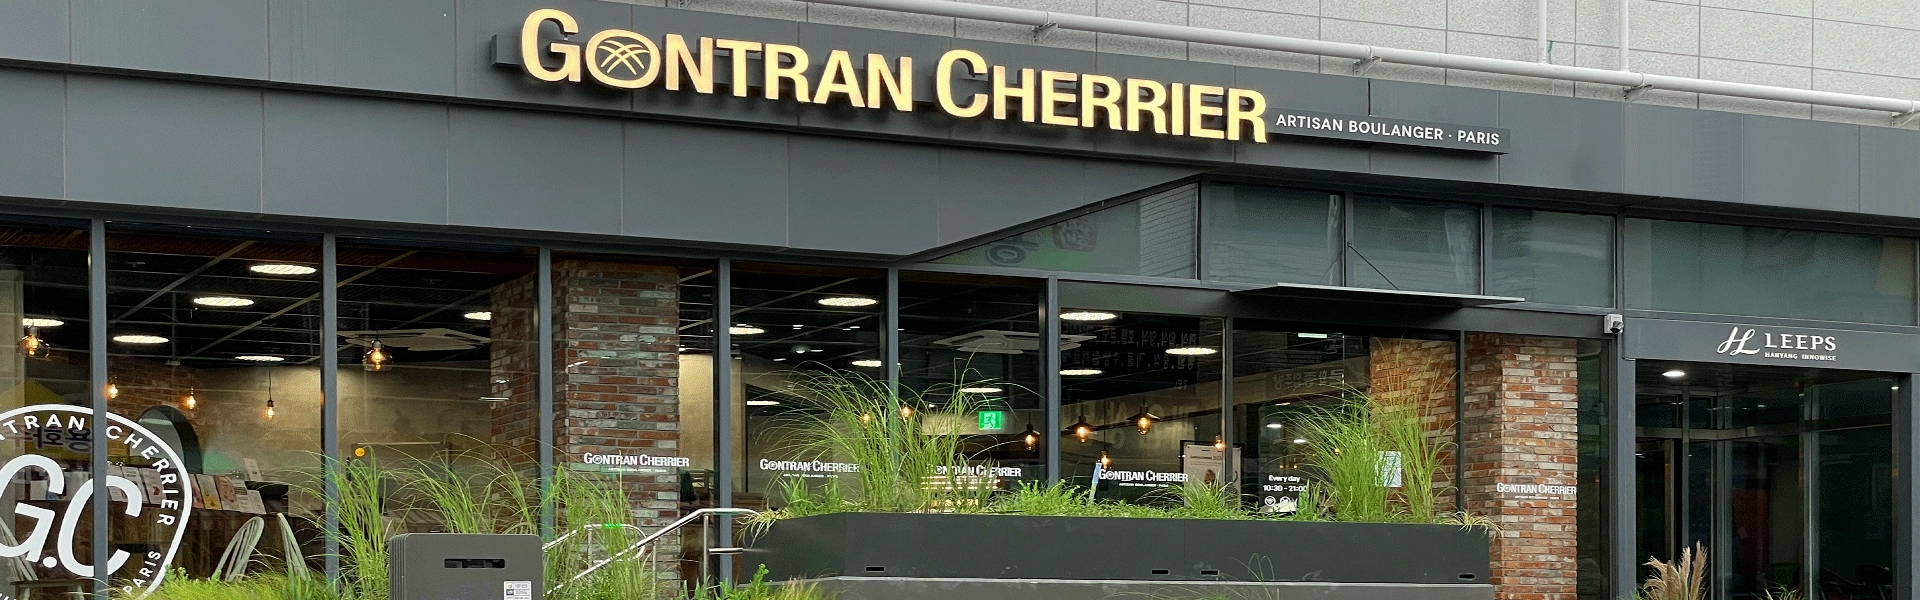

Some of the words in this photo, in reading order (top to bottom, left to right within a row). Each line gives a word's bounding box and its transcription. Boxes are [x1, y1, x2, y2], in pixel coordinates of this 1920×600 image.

[521, 8, 912, 111] GONTRAN
[936, 49, 1268, 144] CHERRIER
[1276, 114, 1343, 132] ARTISAN
[1349, 120, 1443, 141] BOULANGER
[1457, 129, 1500, 146] PARIS
[1764, 333, 1837, 352] LEEPS
[1765, 352, 1798, 360] HANYANG
[1801, 354, 1837, 362] INNOWISE
[583, 452, 638, 466] GONTRAN
[639, 454, 690, 467] CHERRIER
[760, 458, 810, 472] GONTRAN
[812, 460, 860, 473] CHERRIER
[0, 413, 85, 441] TRAN
[106, 425, 180, 527] CHERRIER
[1099, 468, 1145, 481] GONTRAN
[1145, 470, 1189, 482] CHERRIER
[1268, 474, 1287, 483] Every
[1288, 475, 1301, 483] day
[1263, 484, 1283, 492] 10:30
[1496, 482, 1537, 494] GONTRAN
[1538, 483, 1577, 495] CHERRIER
[122, 550, 162, 597] PARIS
